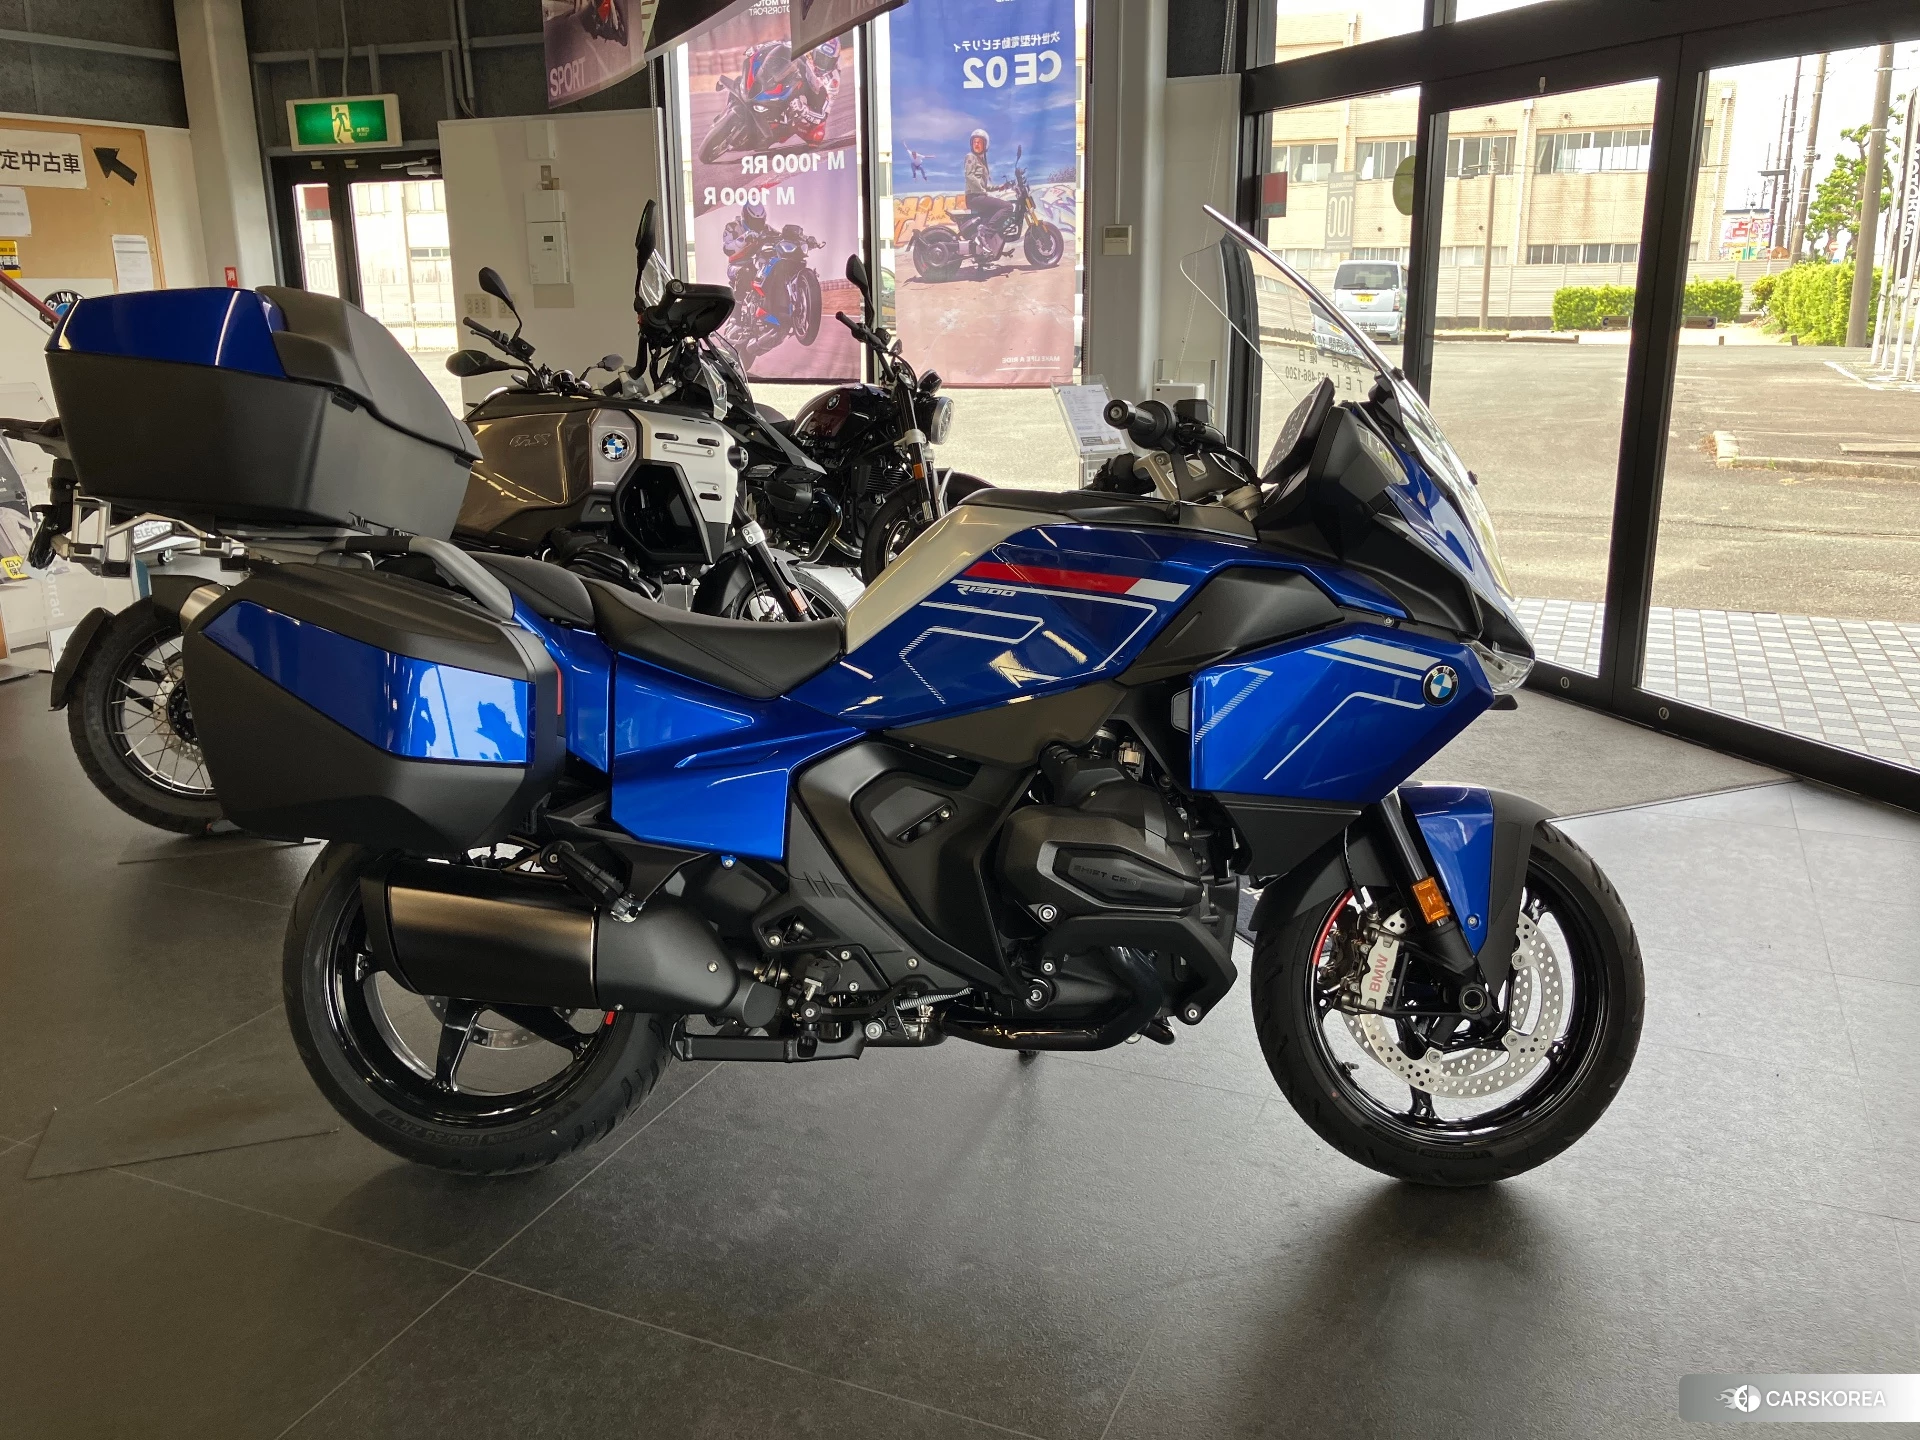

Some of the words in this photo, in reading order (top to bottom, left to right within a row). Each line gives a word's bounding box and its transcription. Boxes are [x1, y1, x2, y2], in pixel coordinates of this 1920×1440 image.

[550, 57, 585, 97] SPORT
[0, 149, 81, 174] 定中古車
[1073, 865, 1107, 878] SHIFT
[1369, 954, 1388, 993] BMW
